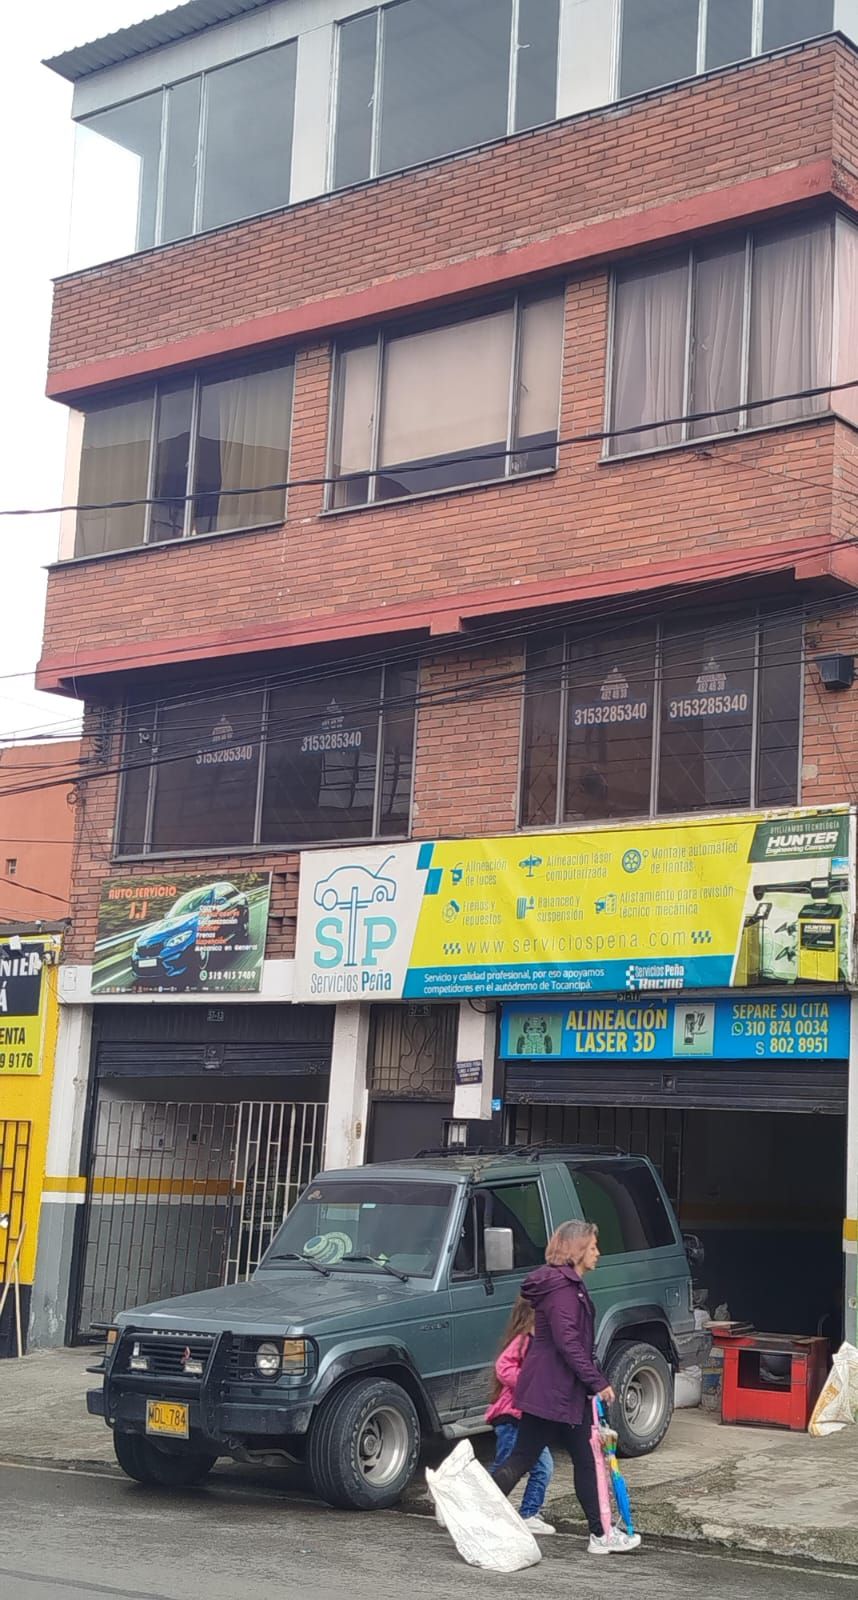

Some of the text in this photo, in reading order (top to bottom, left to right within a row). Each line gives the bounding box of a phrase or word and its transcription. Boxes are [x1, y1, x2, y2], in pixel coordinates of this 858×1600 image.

[575, 702, 647, 725] 3153285340
[670, 694, 747, 718] 3153285340
[301, 731, 362, 752] 3153285340
[196, 746, 252, 765] 3153285340
[767, 831, 839, 848] HUNTER
[547, 853, 589, 867] Alineación
[652, 847, 686, 860] Montaje
[465, 858, 507, 873] Alineación
[650, 860, 694, 873] de llantas
[465, 874, 497, 886] de luces
[545, 866, 607, 882] computarizada
[108, 886, 177, 900] AUTO SERVICIO
[620, 884, 735, 904] Alistamiento para revisión
[463, 900, 496, 912] Frenos y
[537, 895, 581, 908] Balanceo y
[462, 912, 502, 927] repuestos
[536, 909, 584, 923] suspensión
[424, 968, 605, 984] Servicio y calidad profesional, por eso apoyamos
[634, 963, 685, 978] Servicios Peña
[310, 969, 392, 994] Servicios Peña
[424, 983, 473, 995] competidores
[486, 982, 494, 992] el
[495, 981, 538, 992] autódromo
[539, 980, 549, 990] de
[638, 978, 684, 989] RACING
[565, 1003, 667, 1030] ALINEACIÓN
[732, 1002, 829, 1019] SEPARE SU CITA
[745, 1020, 828, 1036] 310 874 0034
[576, 1031, 656, 1052] LASER 3D
[770, 1038, 795, 1053] 802
[798, 1037, 828, 1053] 8951
[8, 1052, 33, 1068] 9176
